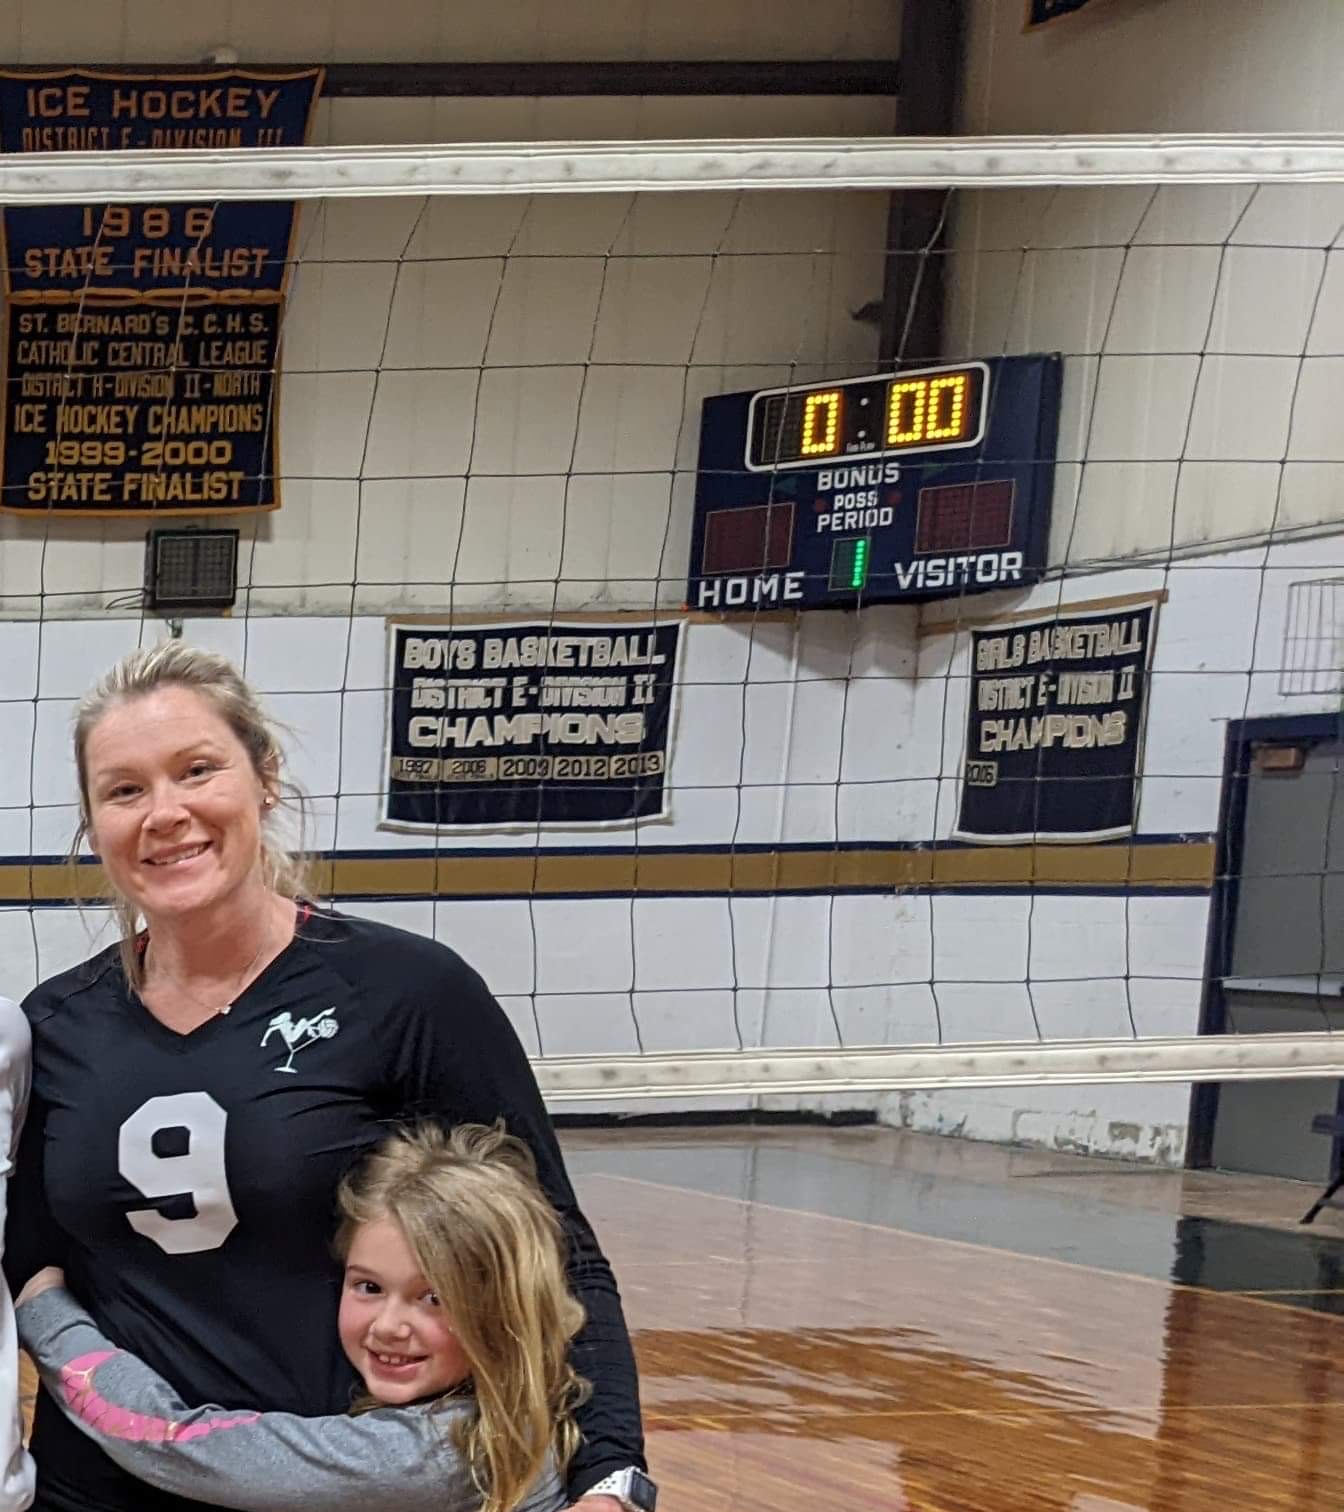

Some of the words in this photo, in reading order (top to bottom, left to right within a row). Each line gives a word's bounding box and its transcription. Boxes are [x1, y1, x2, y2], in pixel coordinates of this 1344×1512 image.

[26, 86, 92, 119] ICE
[113, 87, 281, 120] HOCKEY
[24, 246, 115, 279] STATE
[133, 247, 270, 280] FINALIST
[18, 312, 49, 334] ST.
[57, 311, 170, 336] BERNARD'S
[17, 340, 100, 366] CATHOLIC
[107, 341, 191, 368] CENTRAL
[199, 339, 268, 367] LEAGUE
[21, 373, 84, 397] DISTRICT
[14, 403, 48, 433] ICE
[56, 404, 140, 434] HOCKEY
[147, 403, 263, 435] CHAMPIONS
[44, 439, 233, 466] 1999-2000
[27, 471, 112, 501] STATE
[122, 470, 245, 501] FINALIST
[815, 462, 901, 491] BONUS
[832, 490, 879, 511] POSS
[816, 506, 894, 533] PERIOD
[893, 550, 1024, 590] VISITOR
[697, 571, 805, 608] HOME
[403, 637, 476, 670] BOYS
[482, 634, 666, 669] BASKETBALL
[976, 633, 1026, 671] GIRLS
[1027, 618, 1143, 665] BASKETBALL
[632, 673, 657, 705] II
[408, 711, 647, 748] CHAMPIONS
[980, 710, 1127, 753] CHAMPIONS
[562, 758, 607, 777] 2012
[614, 753, 660, 776] 2013
[118, 1091, 240, 1255] 9
